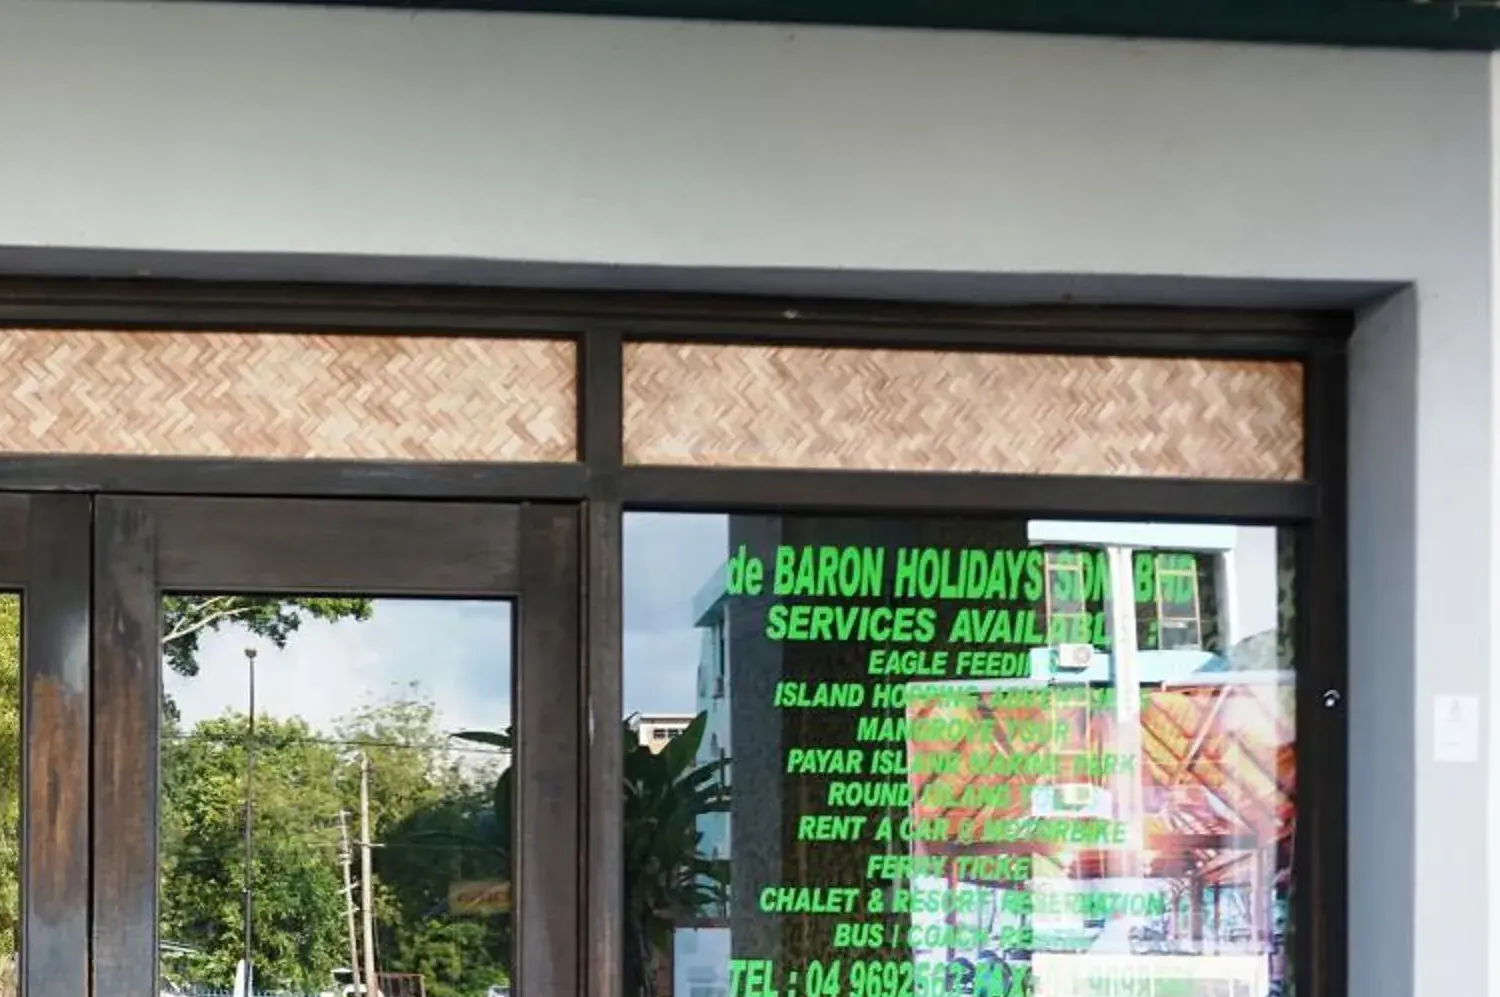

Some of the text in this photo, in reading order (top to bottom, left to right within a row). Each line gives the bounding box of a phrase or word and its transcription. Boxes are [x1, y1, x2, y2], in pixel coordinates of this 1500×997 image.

[725, 544, 764, 596] de
[773, 545, 885, 597] BARON
[894, 547, 1043, 601] HOLIDAYS
[765, 603, 937, 643] SERVICES
[947, 608, 1118, 647] AVAILABL
[867, 649, 1046, 678] EAGLE FEEDI
[773, 681, 866, 708] ISLAND
[786, 748, 864, 774] PAYAR
[869, 749, 962, 776] ISLAND
[827, 781, 915, 807] ROUND
[797, 814, 868, 841] RENT
[873, 815, 895, 841] A
[899, 816, 949, 842] CAR
[866, 855, 1036, 881] FERRY TICKE
[759, 886, 861, 914] CHALET
[866, 888, 885, 913] &
[891, 889, 995, 915] RESORT
[833, 922, 885, 948] BUS
